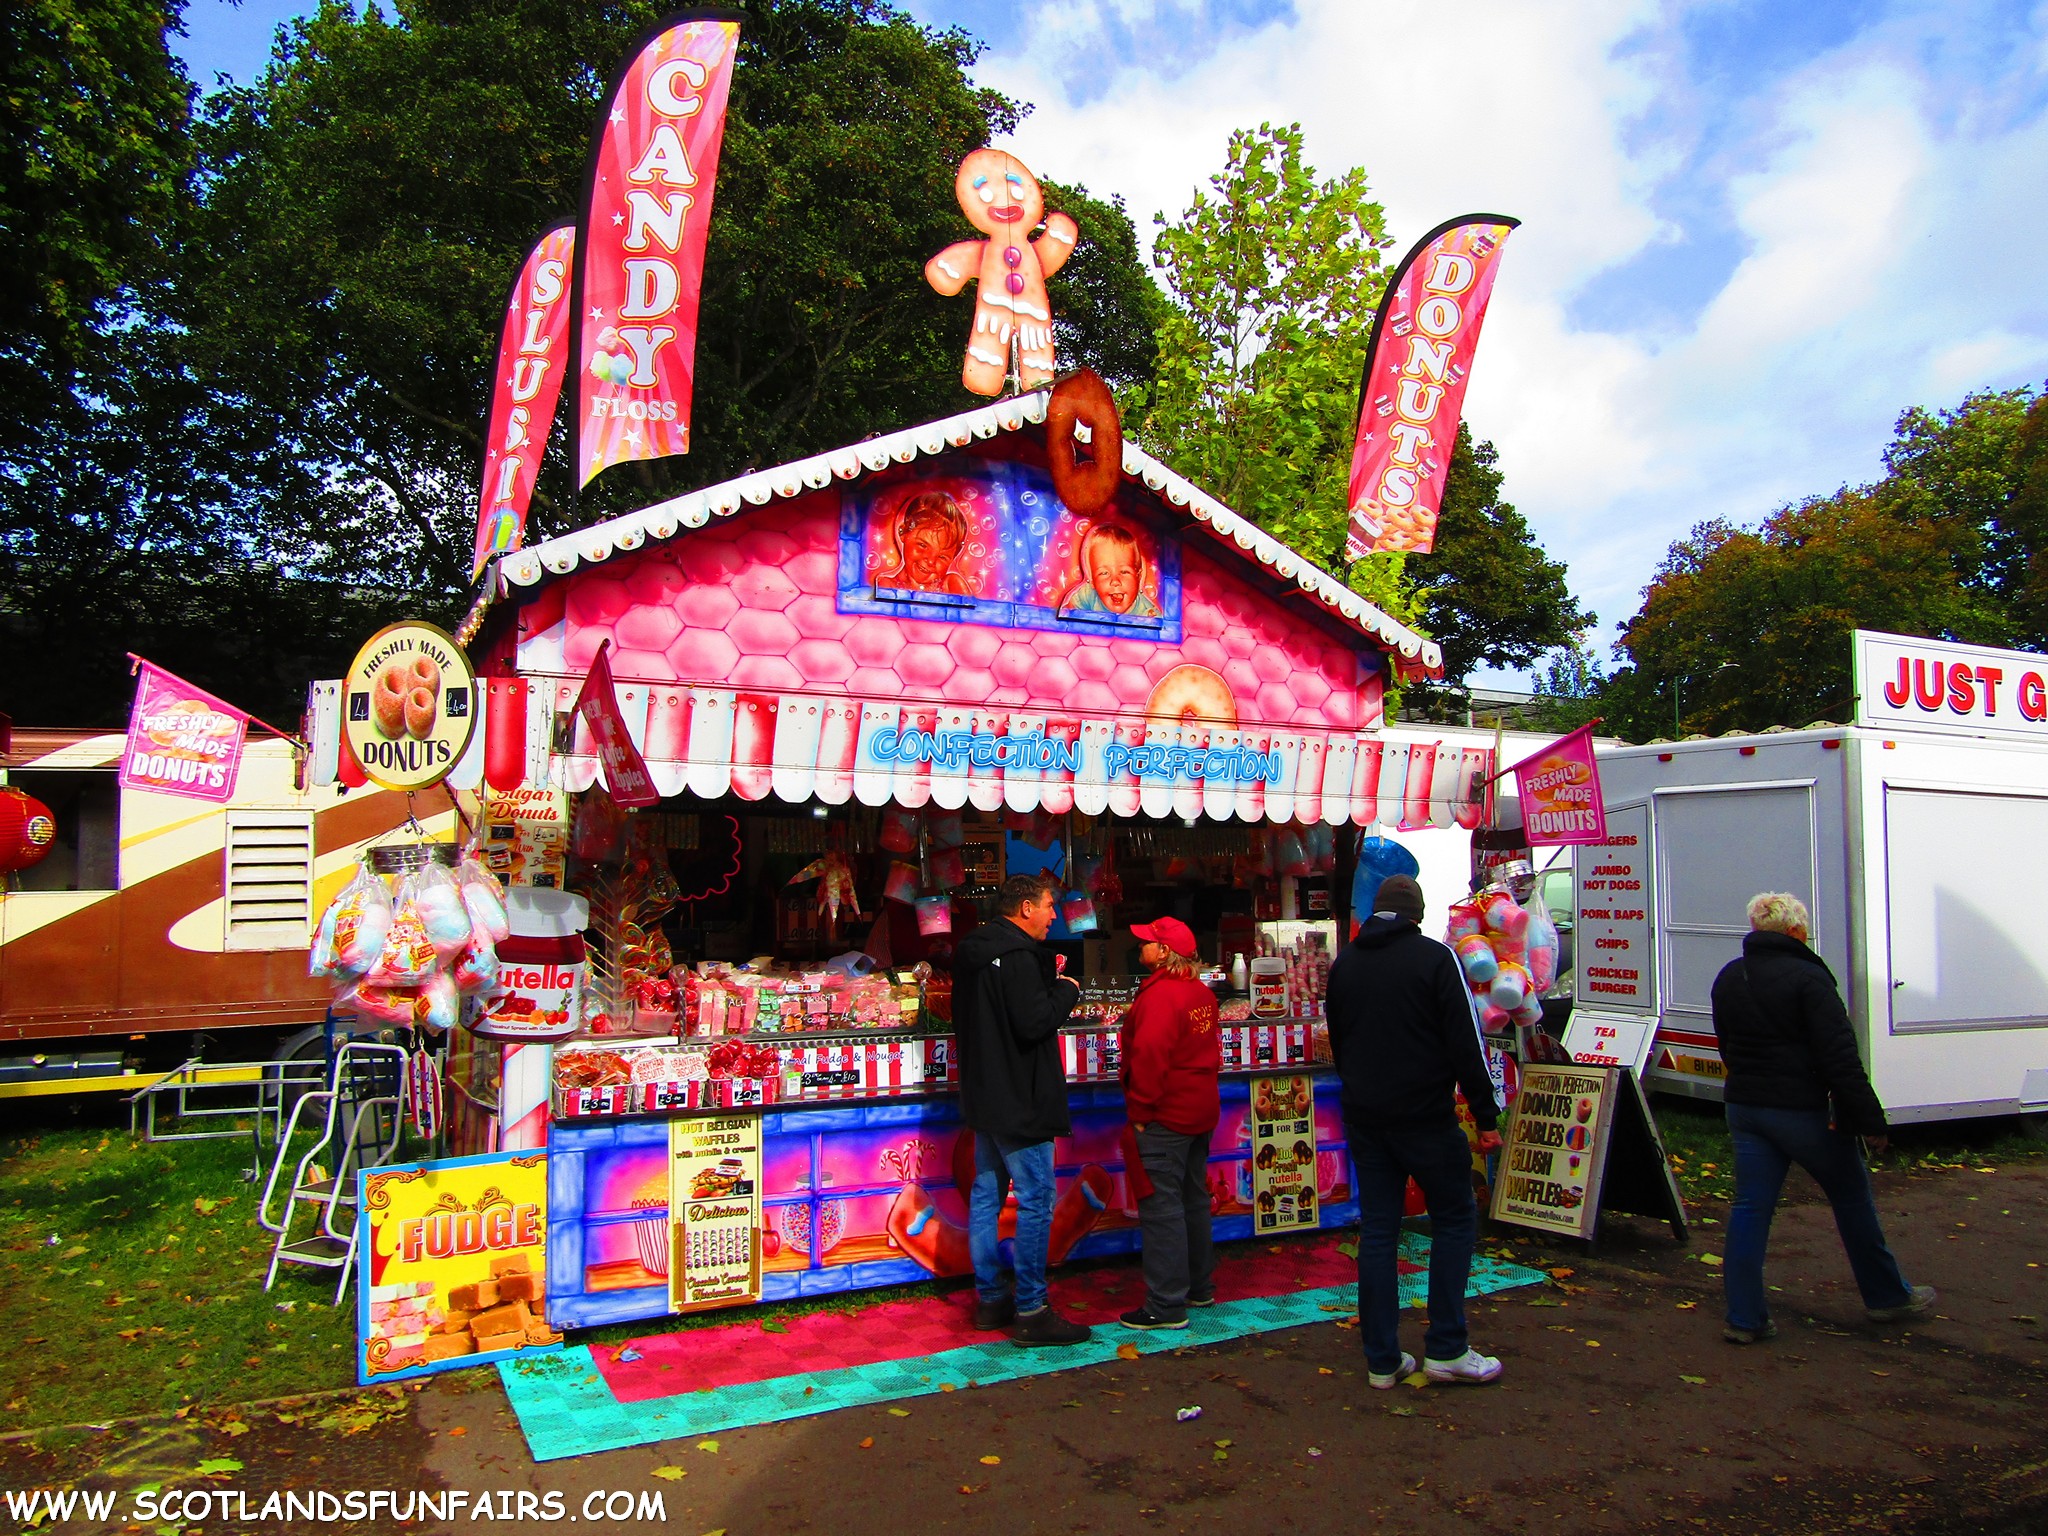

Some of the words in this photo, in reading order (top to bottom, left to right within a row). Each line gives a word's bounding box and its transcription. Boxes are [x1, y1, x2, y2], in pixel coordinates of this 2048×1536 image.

[617, 57, 707, 390] CANDY
[1379, 253, 1475, 509] DONUTS
[591, 396, 678, 423] FLOSS
[363, 639, 415, 680] FRESHLY
[418, 640, 453, 674] MADE
[1884, 657, 2003, 717] JUST
[142, 715, 223, 731] FRESHLY
[176, 734, 231, 758] MADE
[364, 740, 450, 772] DONUTS
[131, 753, 226, 788] DONUTS
[1525, 764, 1577, 793] FRESHLY
[1553, 788, 1592, 802] MADE
[490, 801, 560, 821] Donuts
[1529, 809, 1597, 834] DONUTS
[1585, 835, 1637, 847] GERS
[1591, 865, 1631, 876] JUMBO
[1583, 880, 1607, 890] HOT
[1609, 880, 1641, 891] DOGS
[1581, 908, 1611, 919] PORK
[1614, 909, 1644, 920] BAPS
[1595, 938, 1630, 949] CHIPS
[1587, 966, 1639, 980] CHICKEN
[1255, 985, 1285, 996] nutella
[1589, 981, 1637, 995] BURGER
[1594, 1026, 1617, 1038] TEA
[1077, 1035, 1118, 1051] Belgian
[1594, 1041, 1604, 1051] &
[816, 1052, 849, 1065] Fudge
[853, 1053, 862, 1062] &
[865, 1050, 905, 1062] Nougat
[1574, 1052, 1619, 1065] COFFEE
[1273, 1077, 1290, 1091] Hot
[1525, 1075, 1562, 1094] CONFECTION
[1562, 1076, 1602, 1095] PERFECTION
[1270, 1091, 1295, 1105] Fresh
[1521, 1092, 1572, 1119] DONUTS
[1268, 1106, 1299, 1121] Donuts
[681, 1122, 704, 1134] HOT
[707, 1119, 752, 1132] BELGIAN
[1276, 1124, 1291, 1134] FOR
[1516, 1119, 1565, 1148] CABLES
[692, 1133, 740, 1147] WAFFLES
[676, 1150, 693, 1159] with
[1276, 1146, 1293, 1160] Hot
[1273, 1161, 1298, 1174] Fresh
[1511, 1147, 1554, 1176] SLUSH
[1268, 1172, 1303, 1185] nutella
[1269, 1184, 1302, 1197] Donuts
[1506, 1175, 1563, 1208] WAFFLES
[688, 1201, 750, 1222] Delicious
[1280, 1214, 1295, 1222] FOR
[399, 1203, 541, 1263] FUDGE
